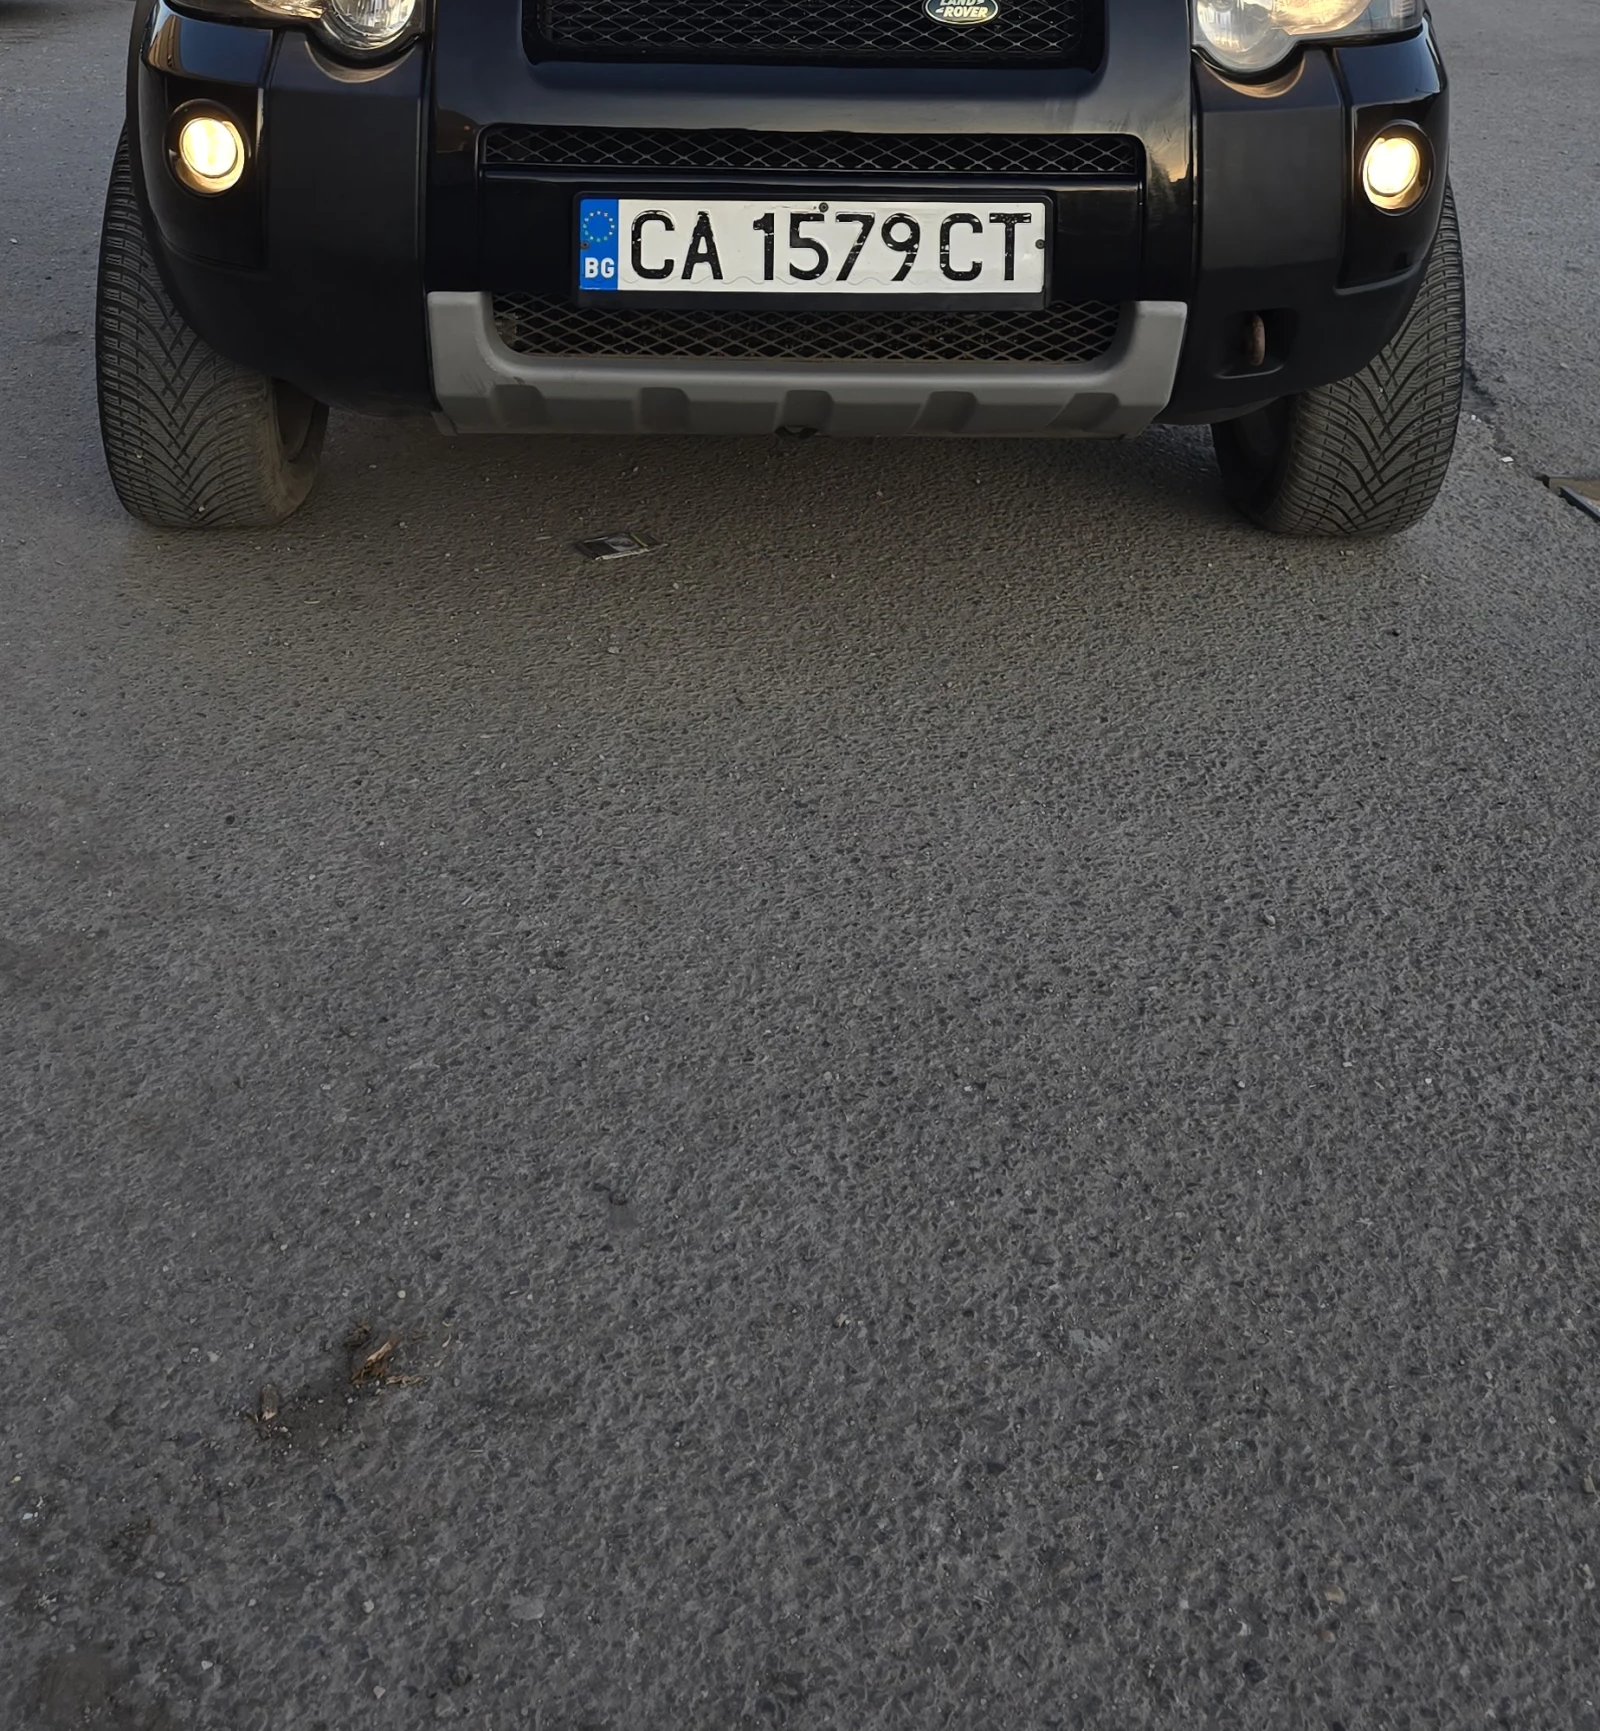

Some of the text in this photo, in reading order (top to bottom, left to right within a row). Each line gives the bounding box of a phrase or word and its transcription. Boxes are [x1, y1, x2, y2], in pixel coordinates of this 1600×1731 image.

[943, 6, 989, 18] ROVER
[631, 209, 1032, 281] CA 1579 CT
[584, 257, 615, 279] BG
